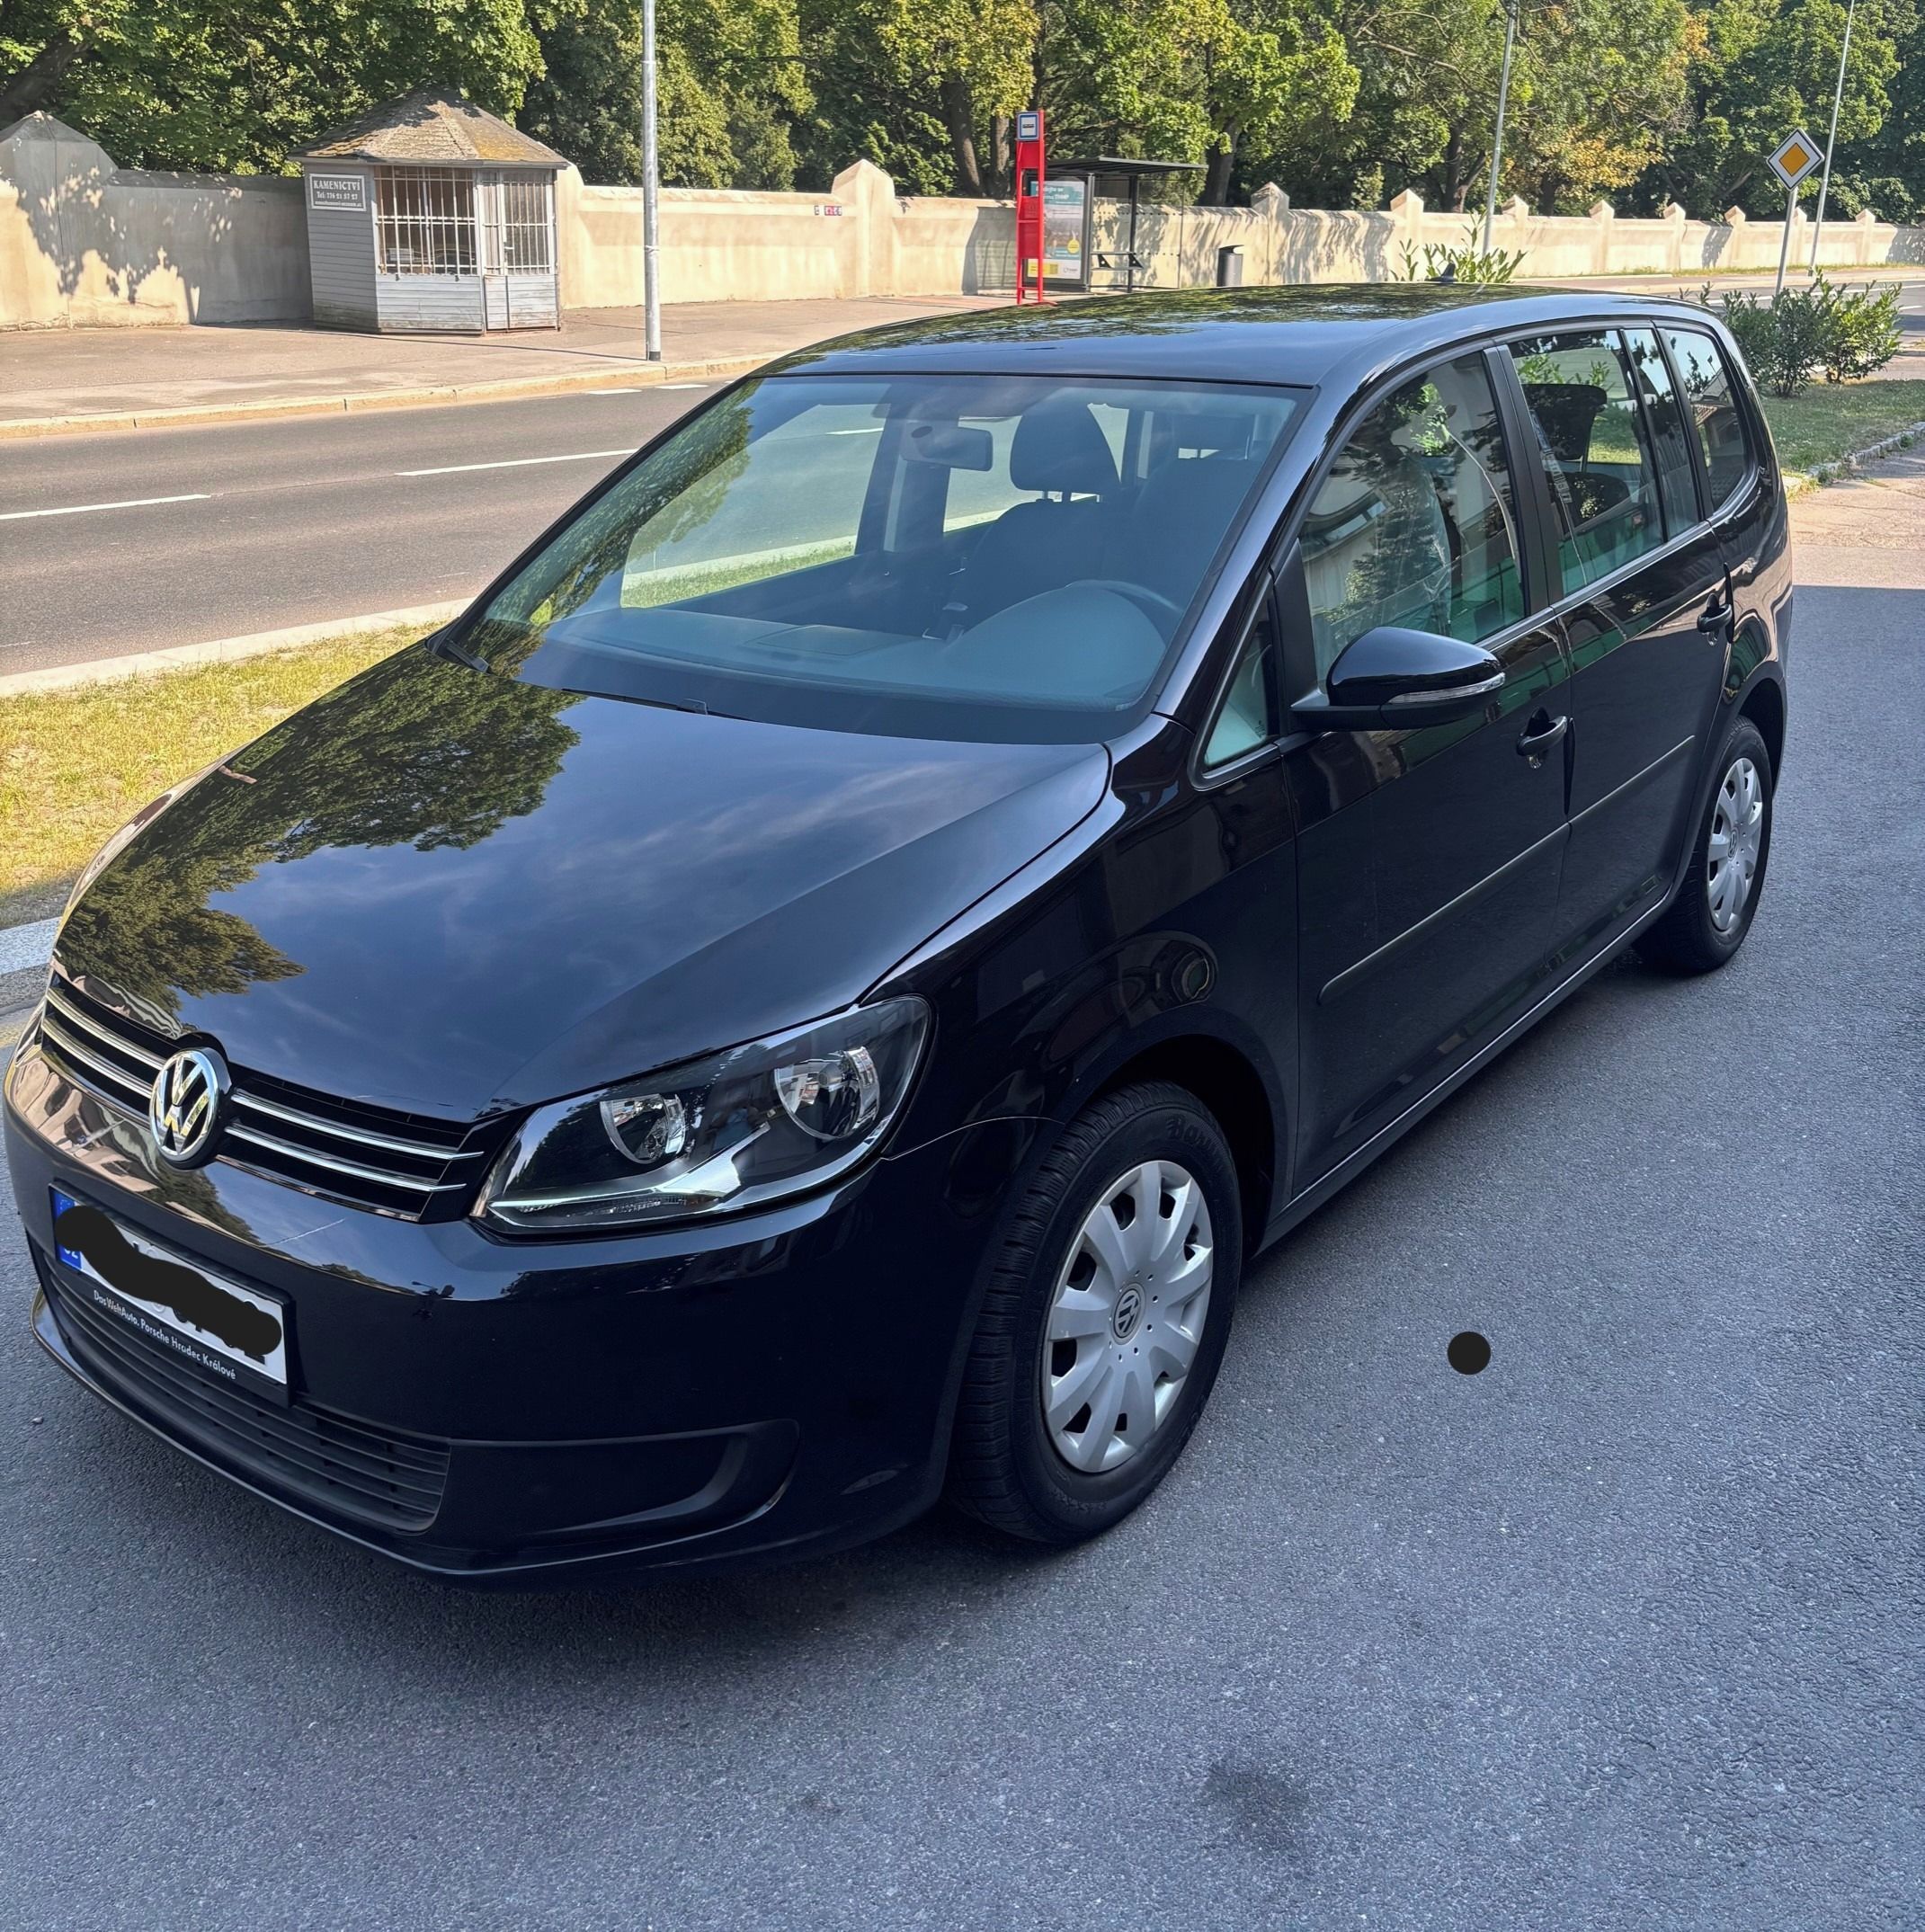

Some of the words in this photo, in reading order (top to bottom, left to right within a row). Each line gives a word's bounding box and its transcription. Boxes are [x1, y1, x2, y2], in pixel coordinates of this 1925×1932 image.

[314, 180, 360, 191] KAMENICTVÍ
[140, 1318, 170, 1343] Porsche
[171, 1336, 201, 1361] Hradec
[202, 1353, 236, 1380] Králové
